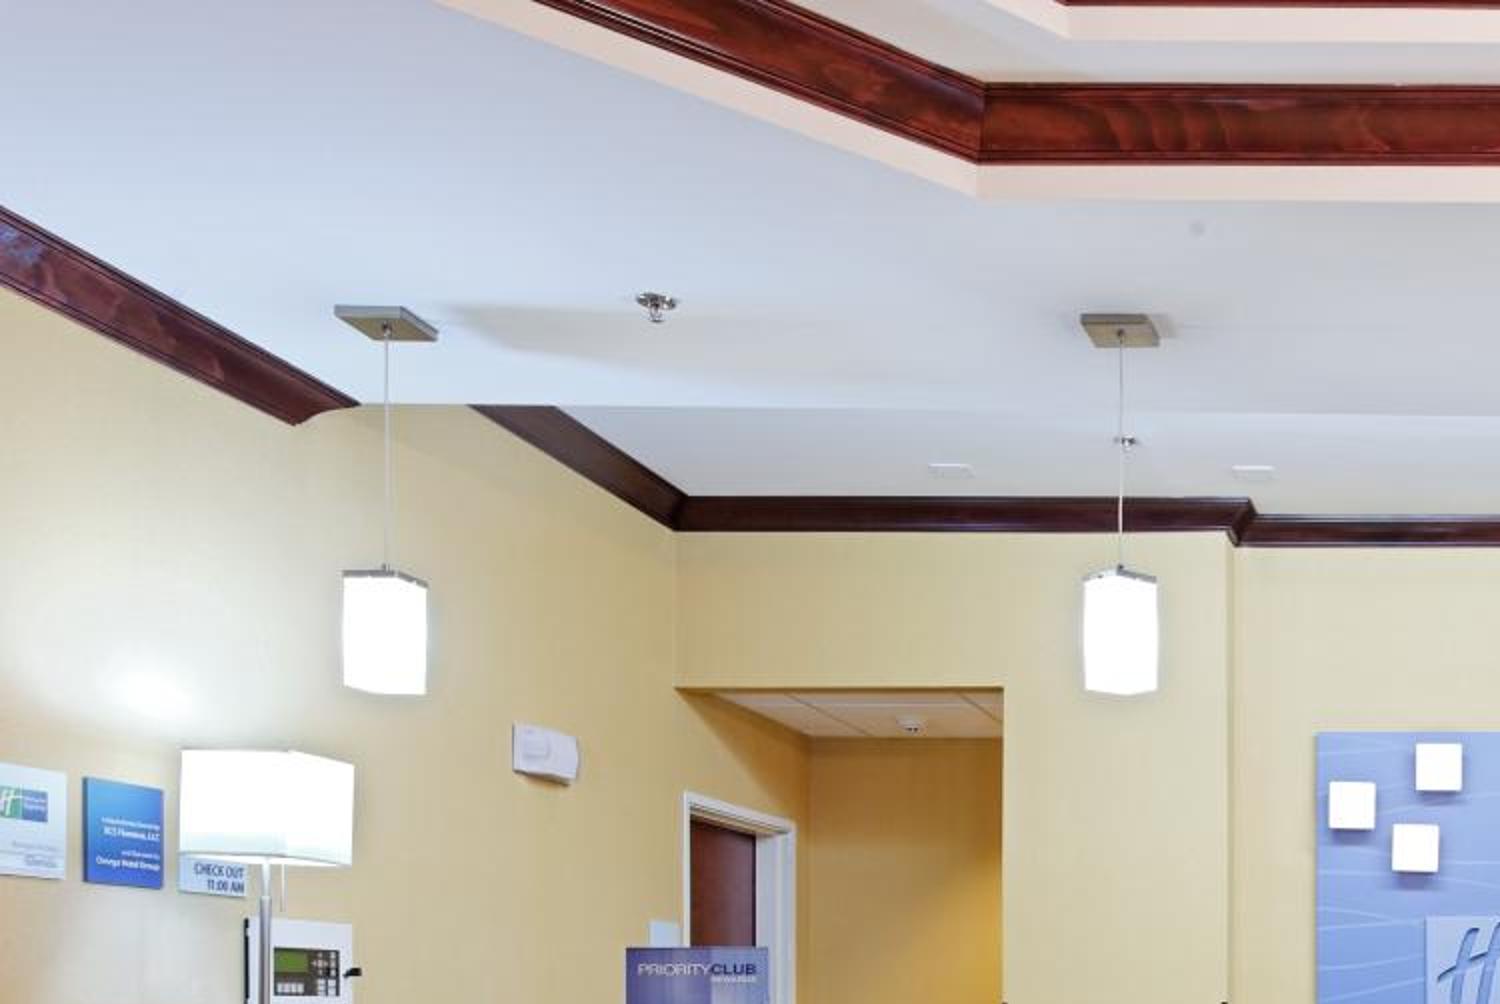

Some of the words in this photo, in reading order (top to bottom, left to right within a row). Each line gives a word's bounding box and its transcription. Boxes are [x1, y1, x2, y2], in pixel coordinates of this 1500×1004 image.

[193, 862, 224, 877] CHECK
[225, 865, 244, 879] OUT
[231, 880, 244, 893] AM
